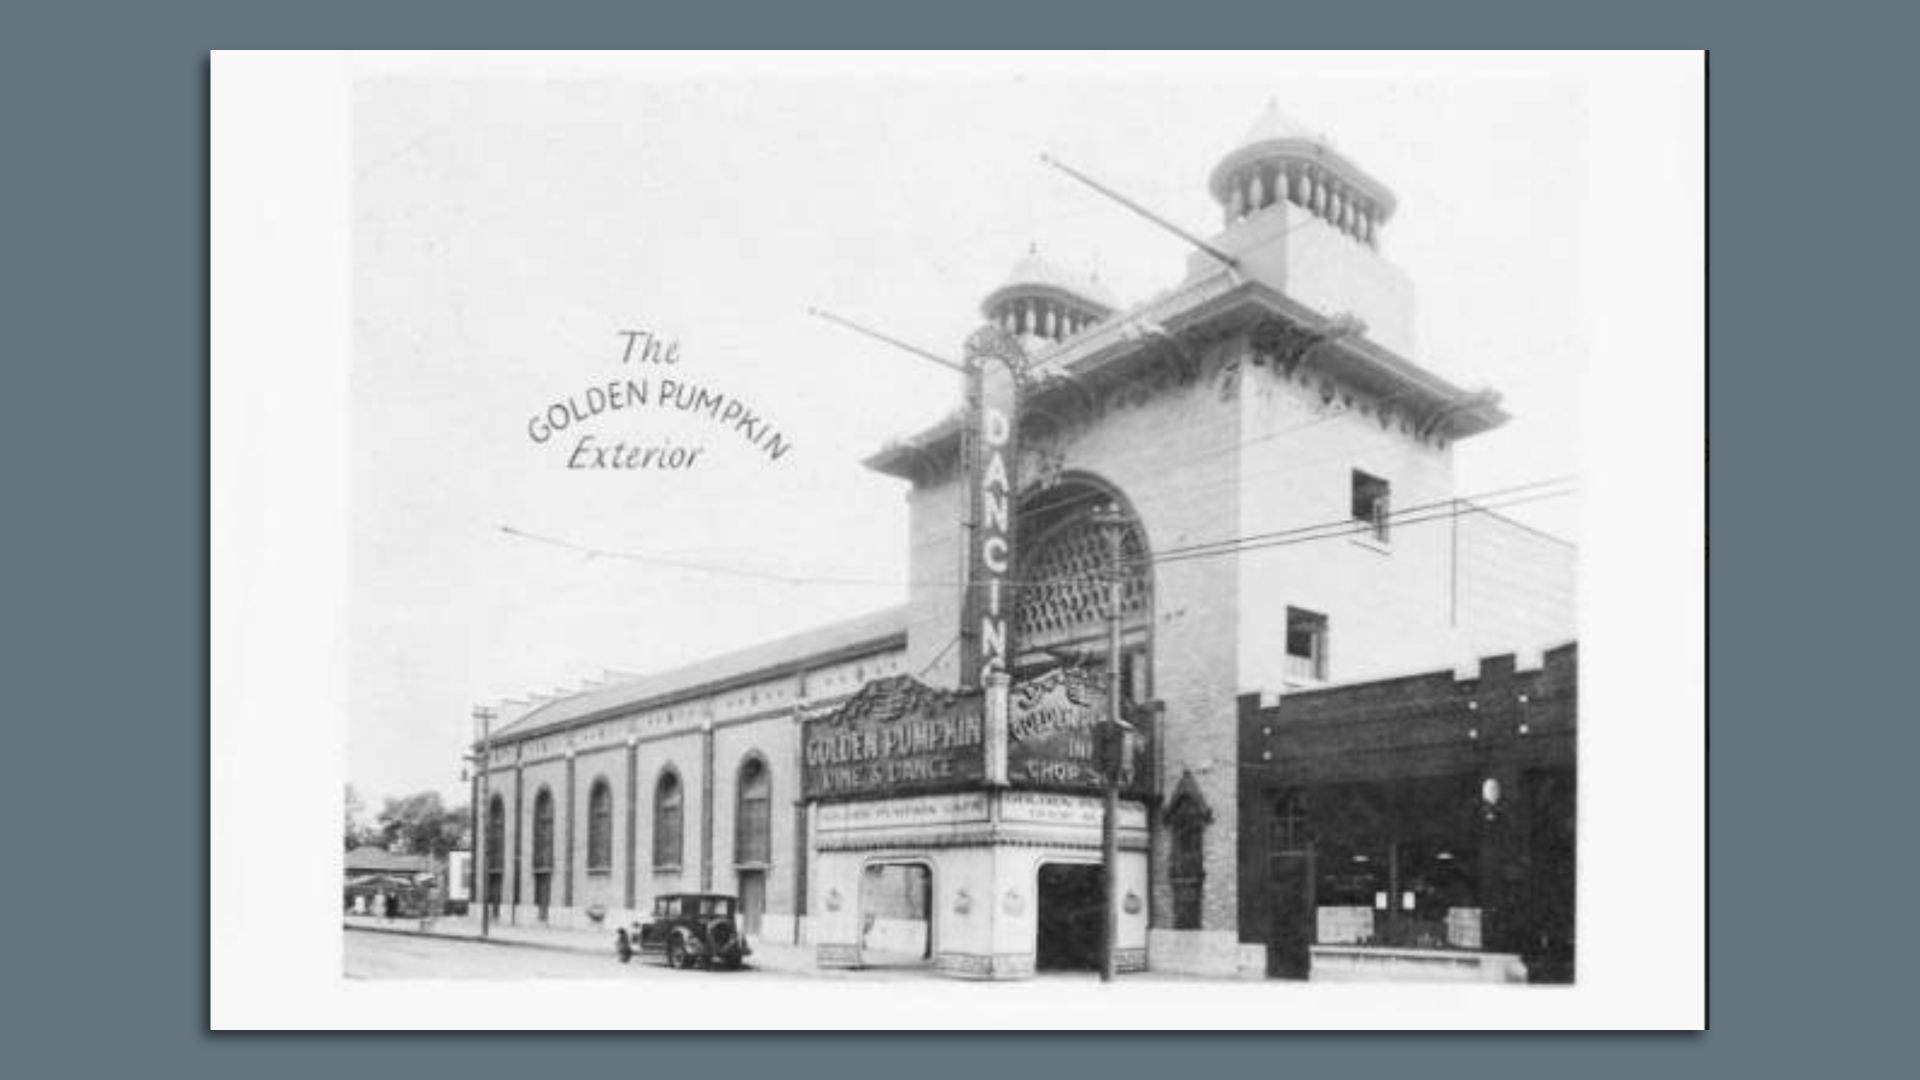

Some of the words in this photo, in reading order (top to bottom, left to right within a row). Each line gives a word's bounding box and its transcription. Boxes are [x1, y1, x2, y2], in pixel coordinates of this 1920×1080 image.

[806, 726, 878, 766] GOLDEN
[884, 714, 982, 757] PUMPKIN
[1027, 758, 1080, 782] CHOP
